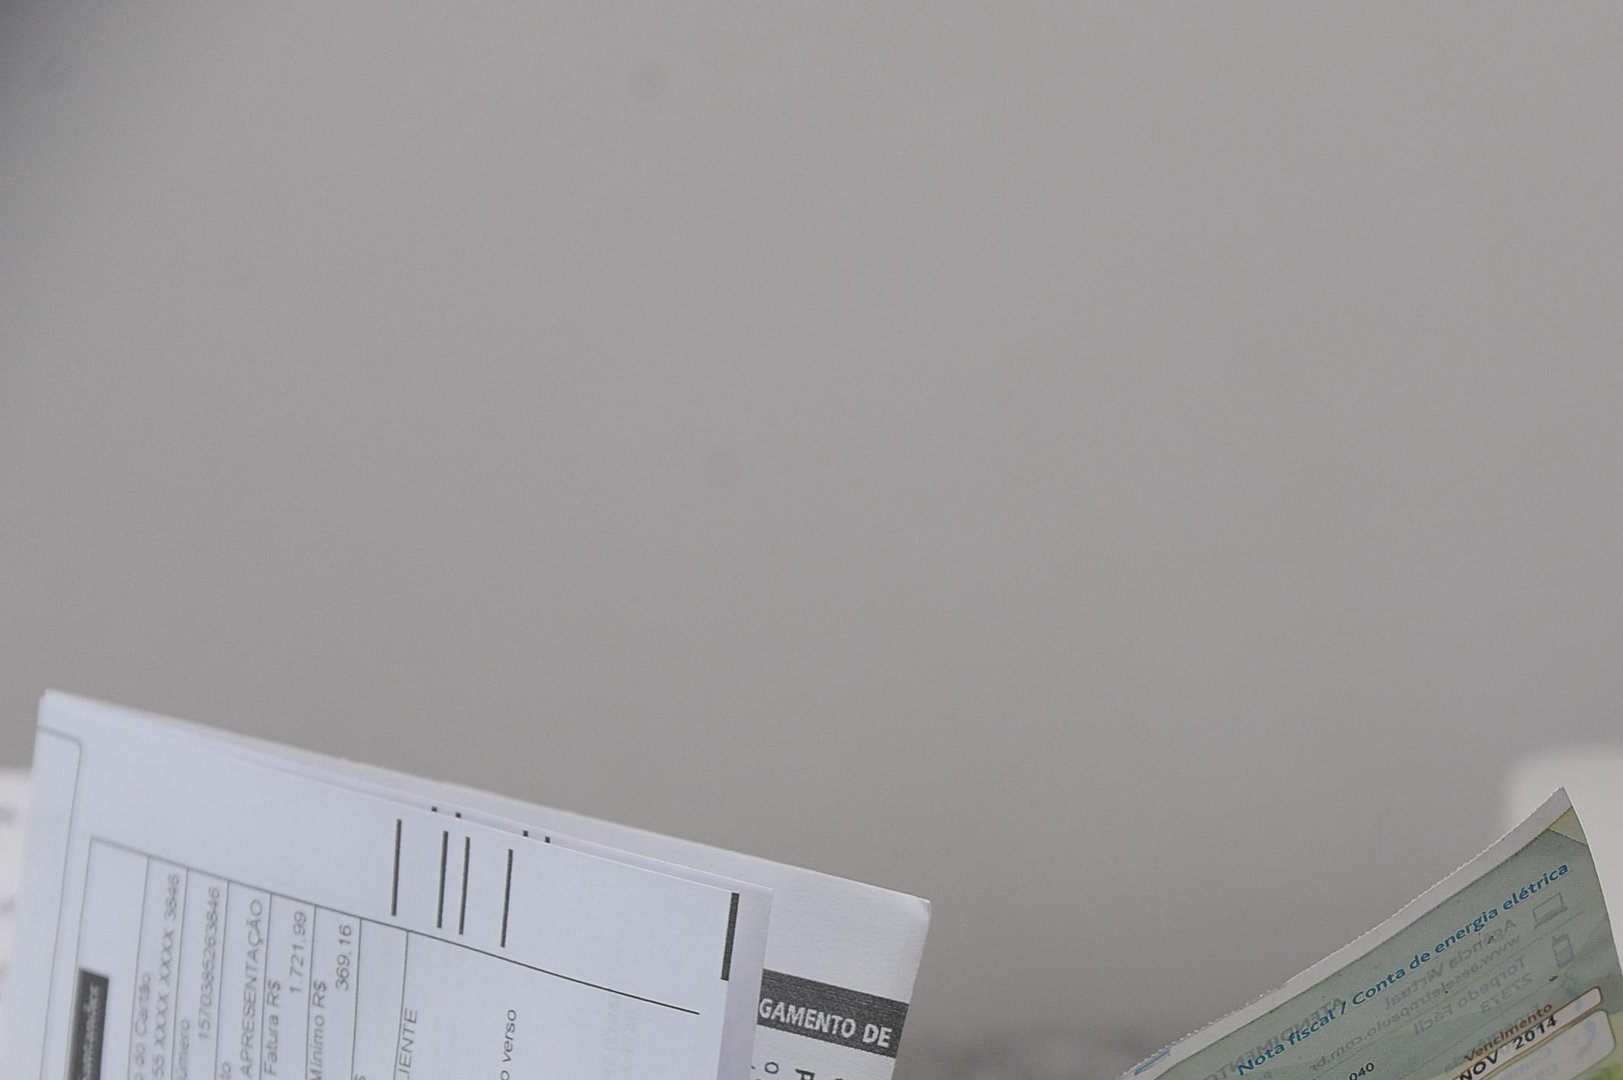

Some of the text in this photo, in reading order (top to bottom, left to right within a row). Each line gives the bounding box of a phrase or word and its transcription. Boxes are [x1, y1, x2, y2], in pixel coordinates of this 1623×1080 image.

[240, 899, 263, 1077] APRESENTAÇÃO
[267, 978, 282, 1009] R$
[313, 979, 328, 1010] R$
[1236, 862, 1570, 1077] Nota fiscal Conta de energia elétrica
[264, 1012, 280, 1076] Fatura
[502, 1008, 517, 1064] verso
[862, 1022, 893, 1048] DE
[1464, 1003, 1553, 1063] Vencimento
[1512, 1015, 1559, 1050] 2014
